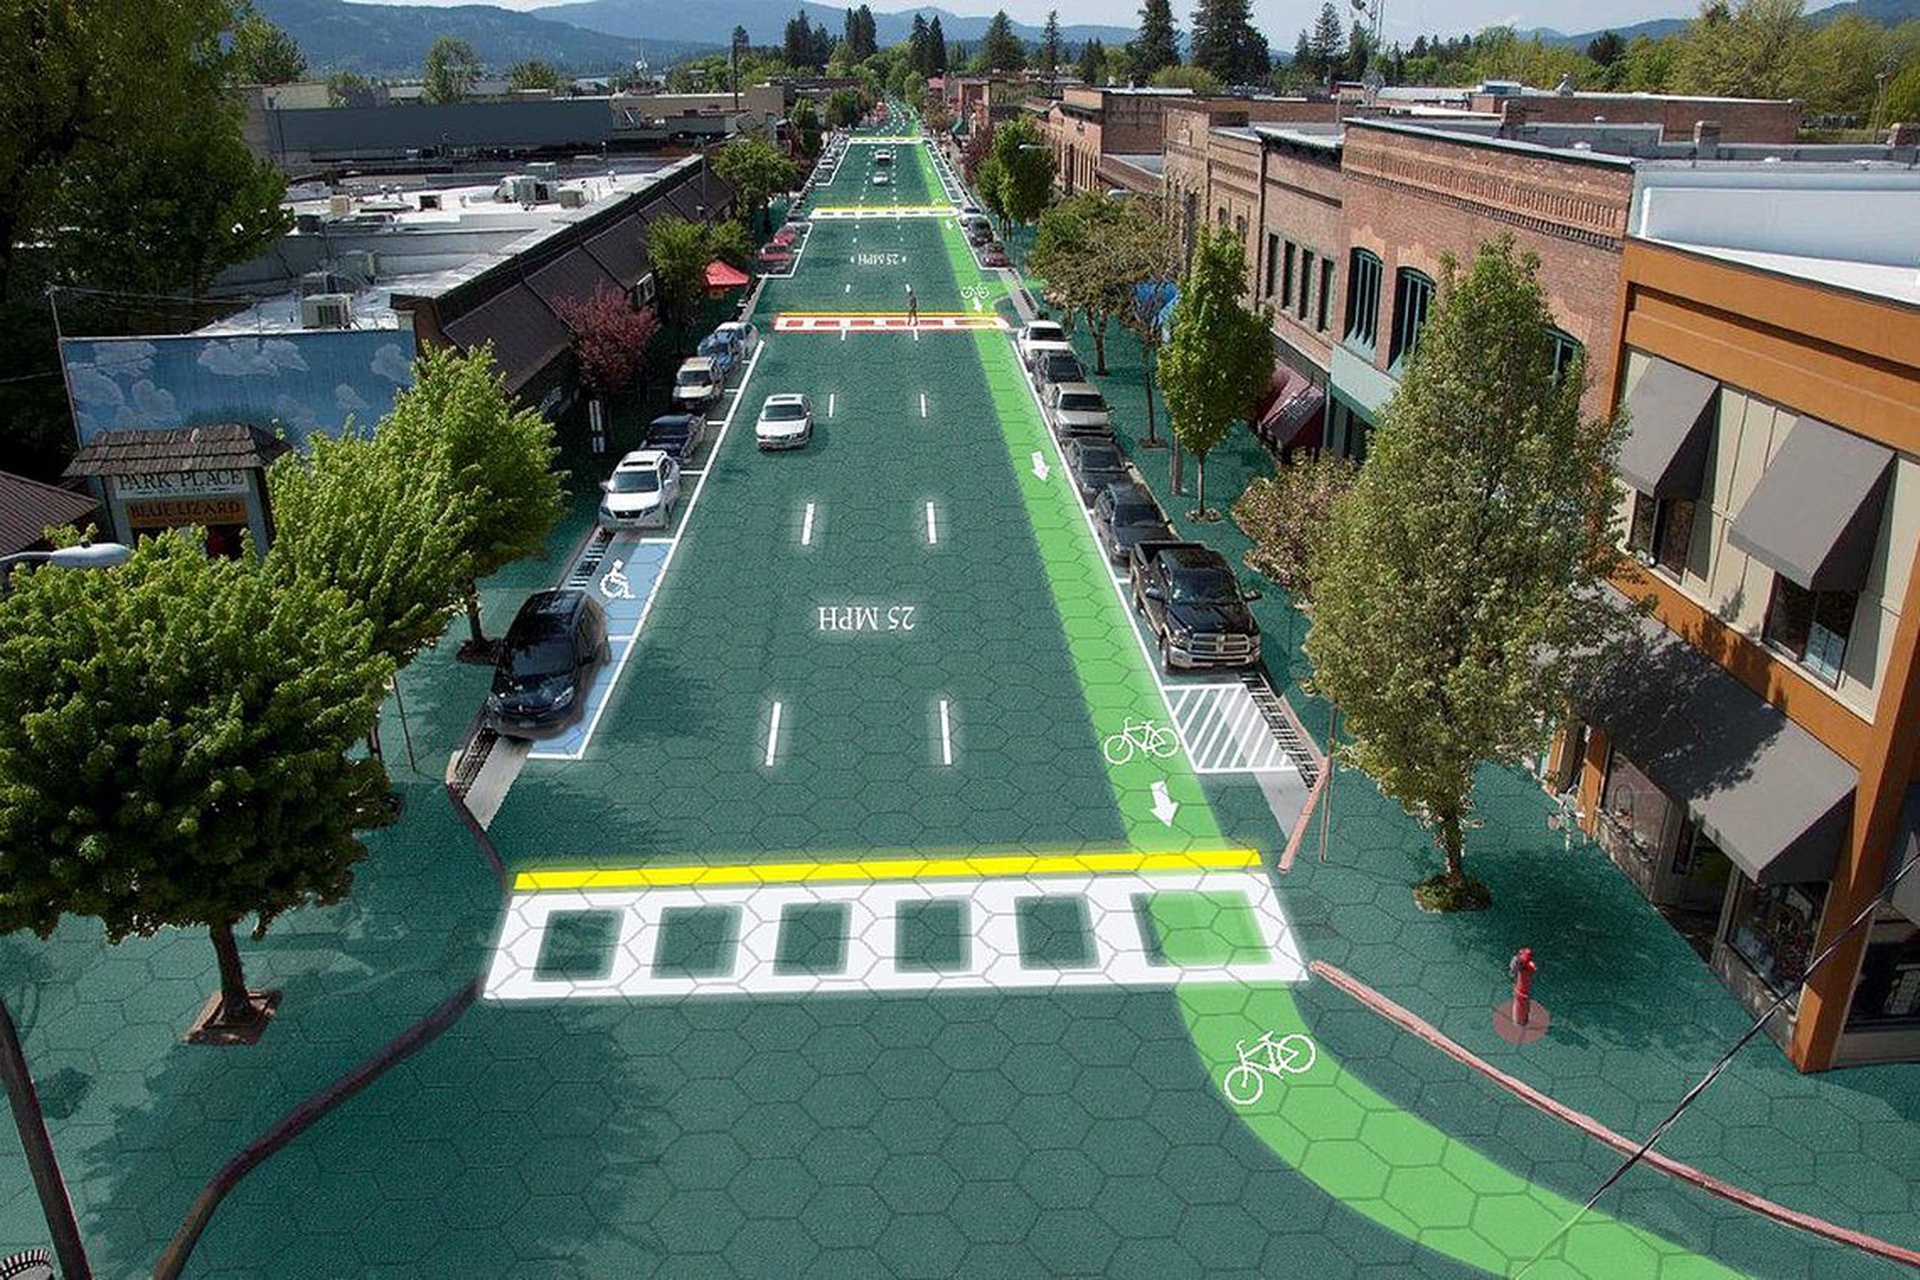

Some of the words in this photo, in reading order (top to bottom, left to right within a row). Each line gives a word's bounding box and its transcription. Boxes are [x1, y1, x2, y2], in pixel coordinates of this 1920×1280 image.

[118, 472, 172, 490] PARK
[180, 468, 244, 487] PLACE
[177, 499, 241, 515] LIZARD
[817, 606, 879, 631] MPH
[887, 605, 915, 631] 25
